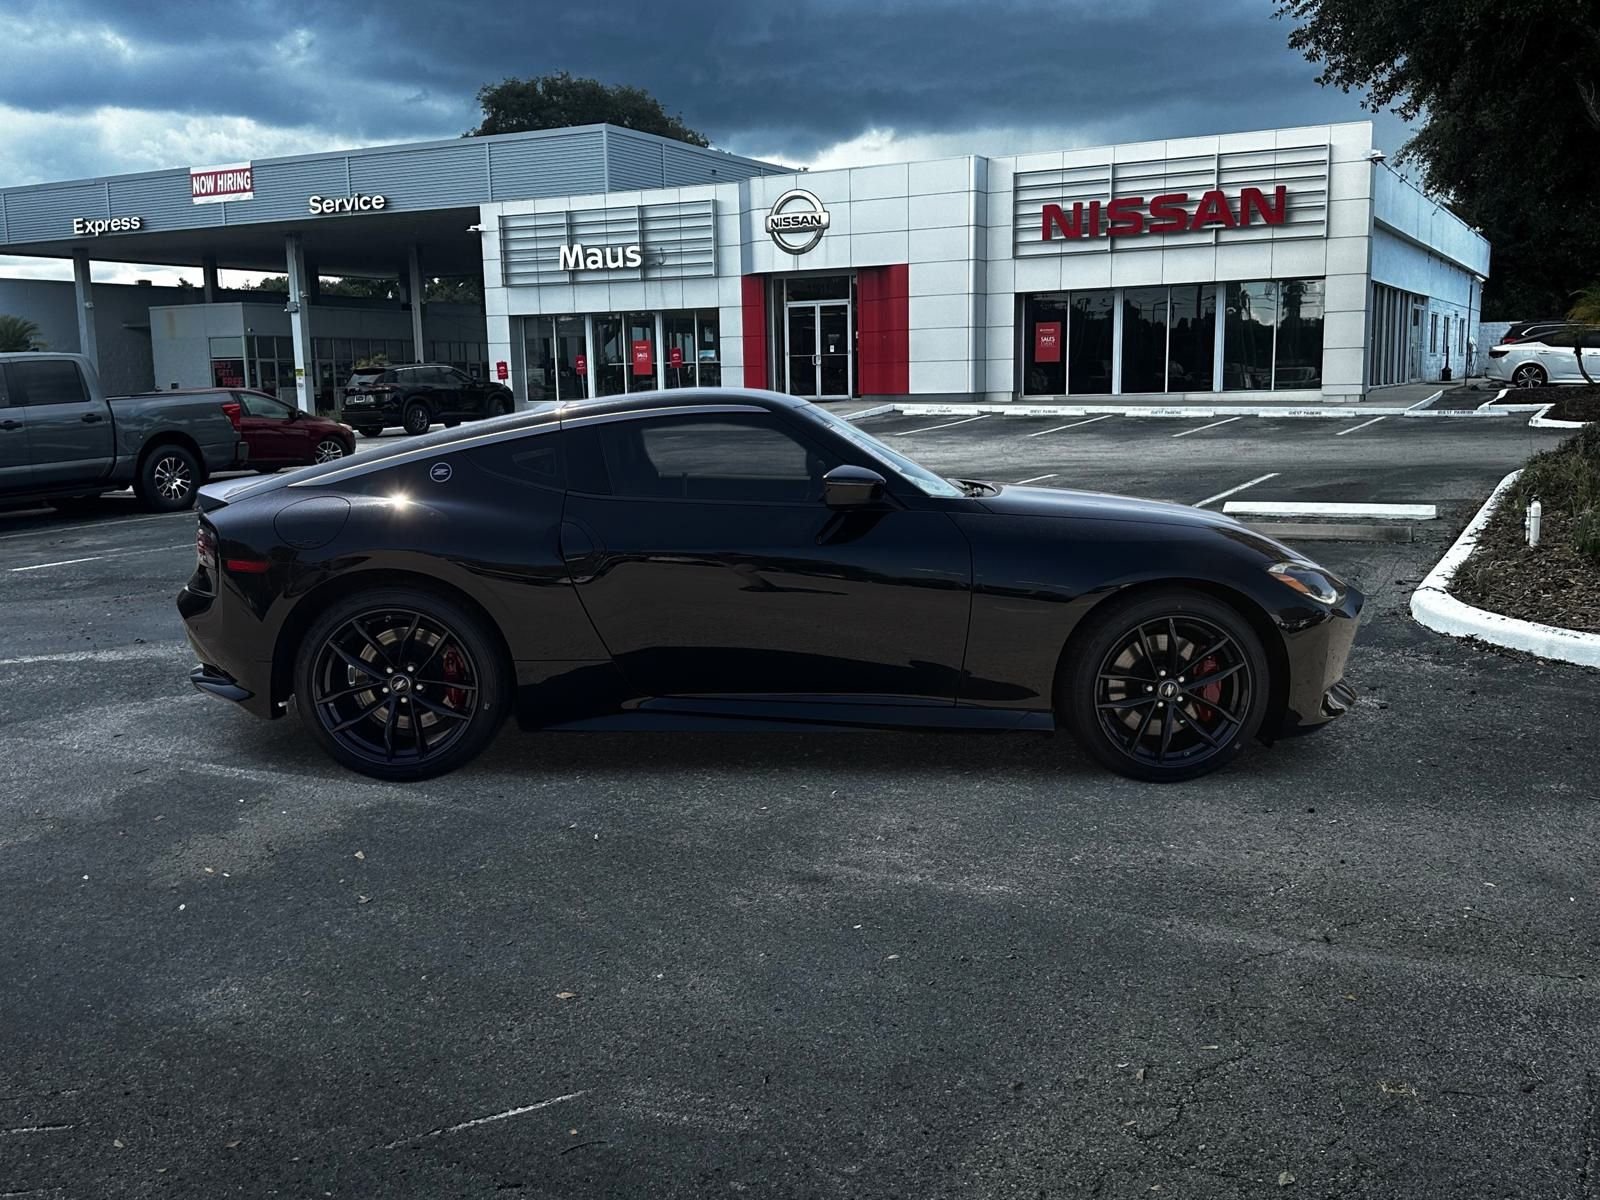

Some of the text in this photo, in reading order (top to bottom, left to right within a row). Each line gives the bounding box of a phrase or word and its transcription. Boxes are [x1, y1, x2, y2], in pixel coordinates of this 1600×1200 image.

[193, 171, 251, 195] NOW HIRING
[309, 193, 385, 214] Service
[1042, 185, 1287, 241] NISSAN
[73, 216, 141, 236] Express
[770, 215, 822, 228] NISSAN
[560, 243, 641, 270] Maus
